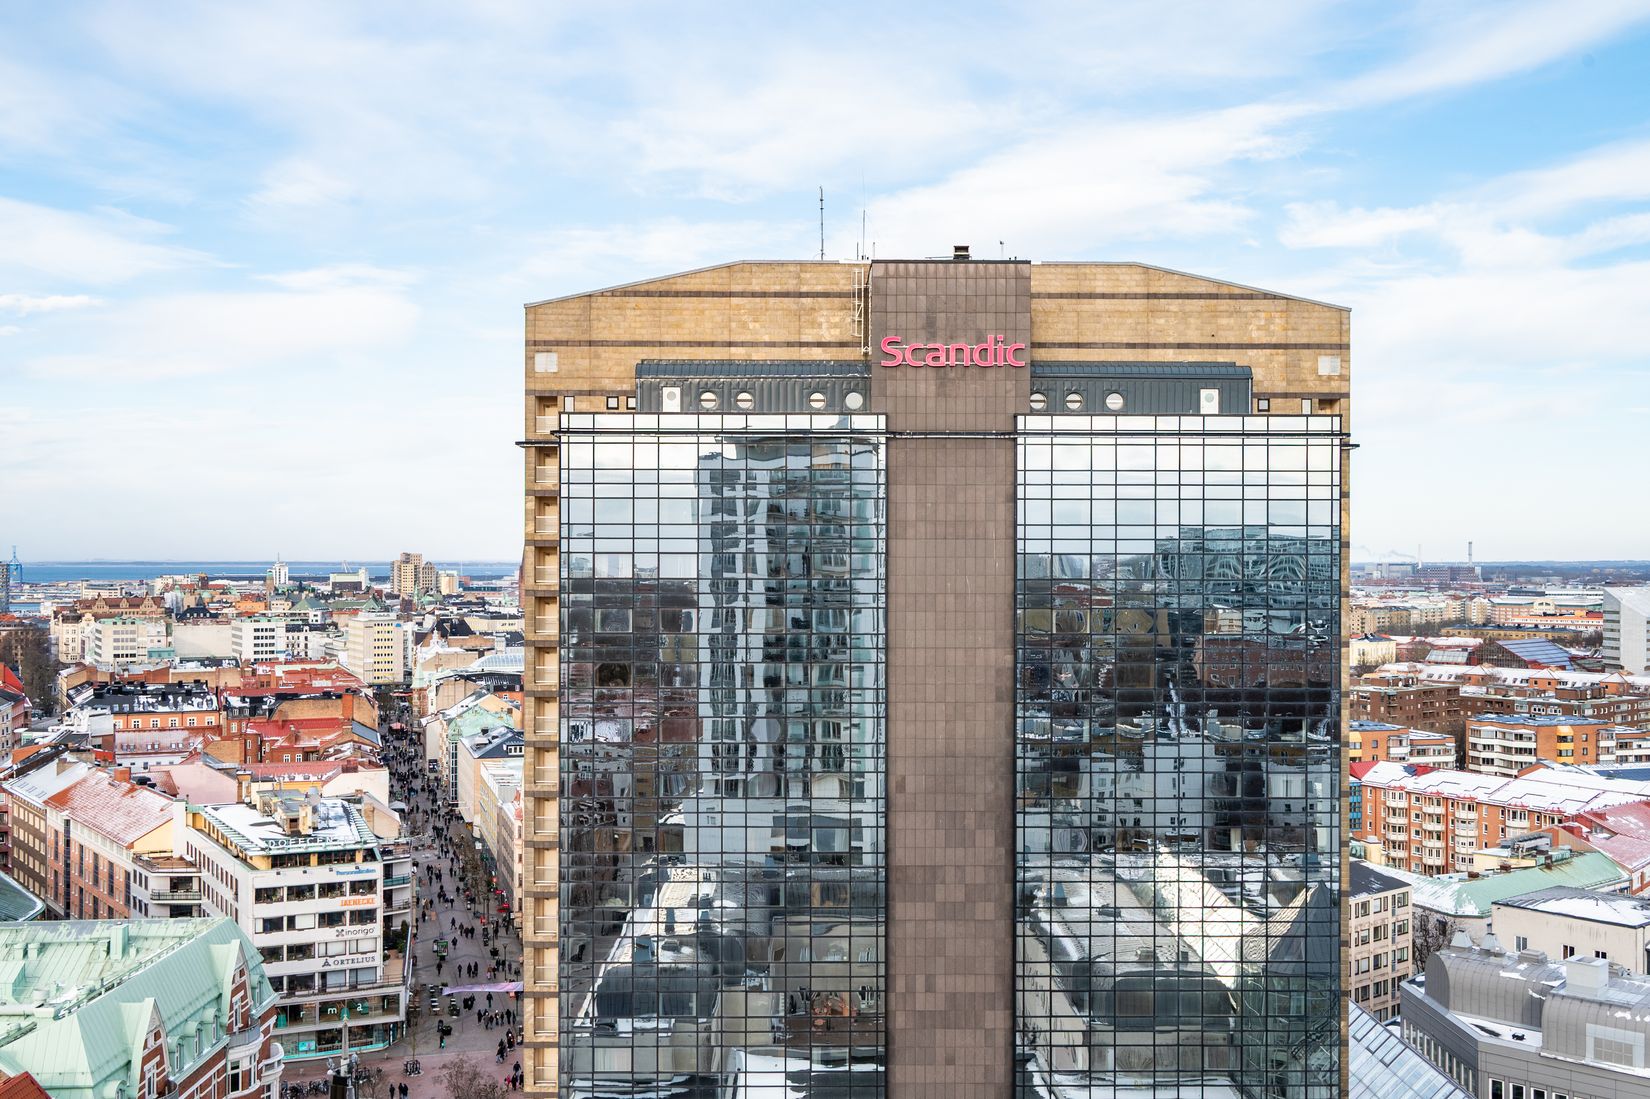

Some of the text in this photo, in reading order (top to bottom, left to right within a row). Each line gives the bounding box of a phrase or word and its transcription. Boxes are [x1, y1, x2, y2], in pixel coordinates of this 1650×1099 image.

[880, 334, 1026, 367] Scandic
[345, 927, 375, 936] inorigo
[333, 956, 376, 966] ORTELIUS
